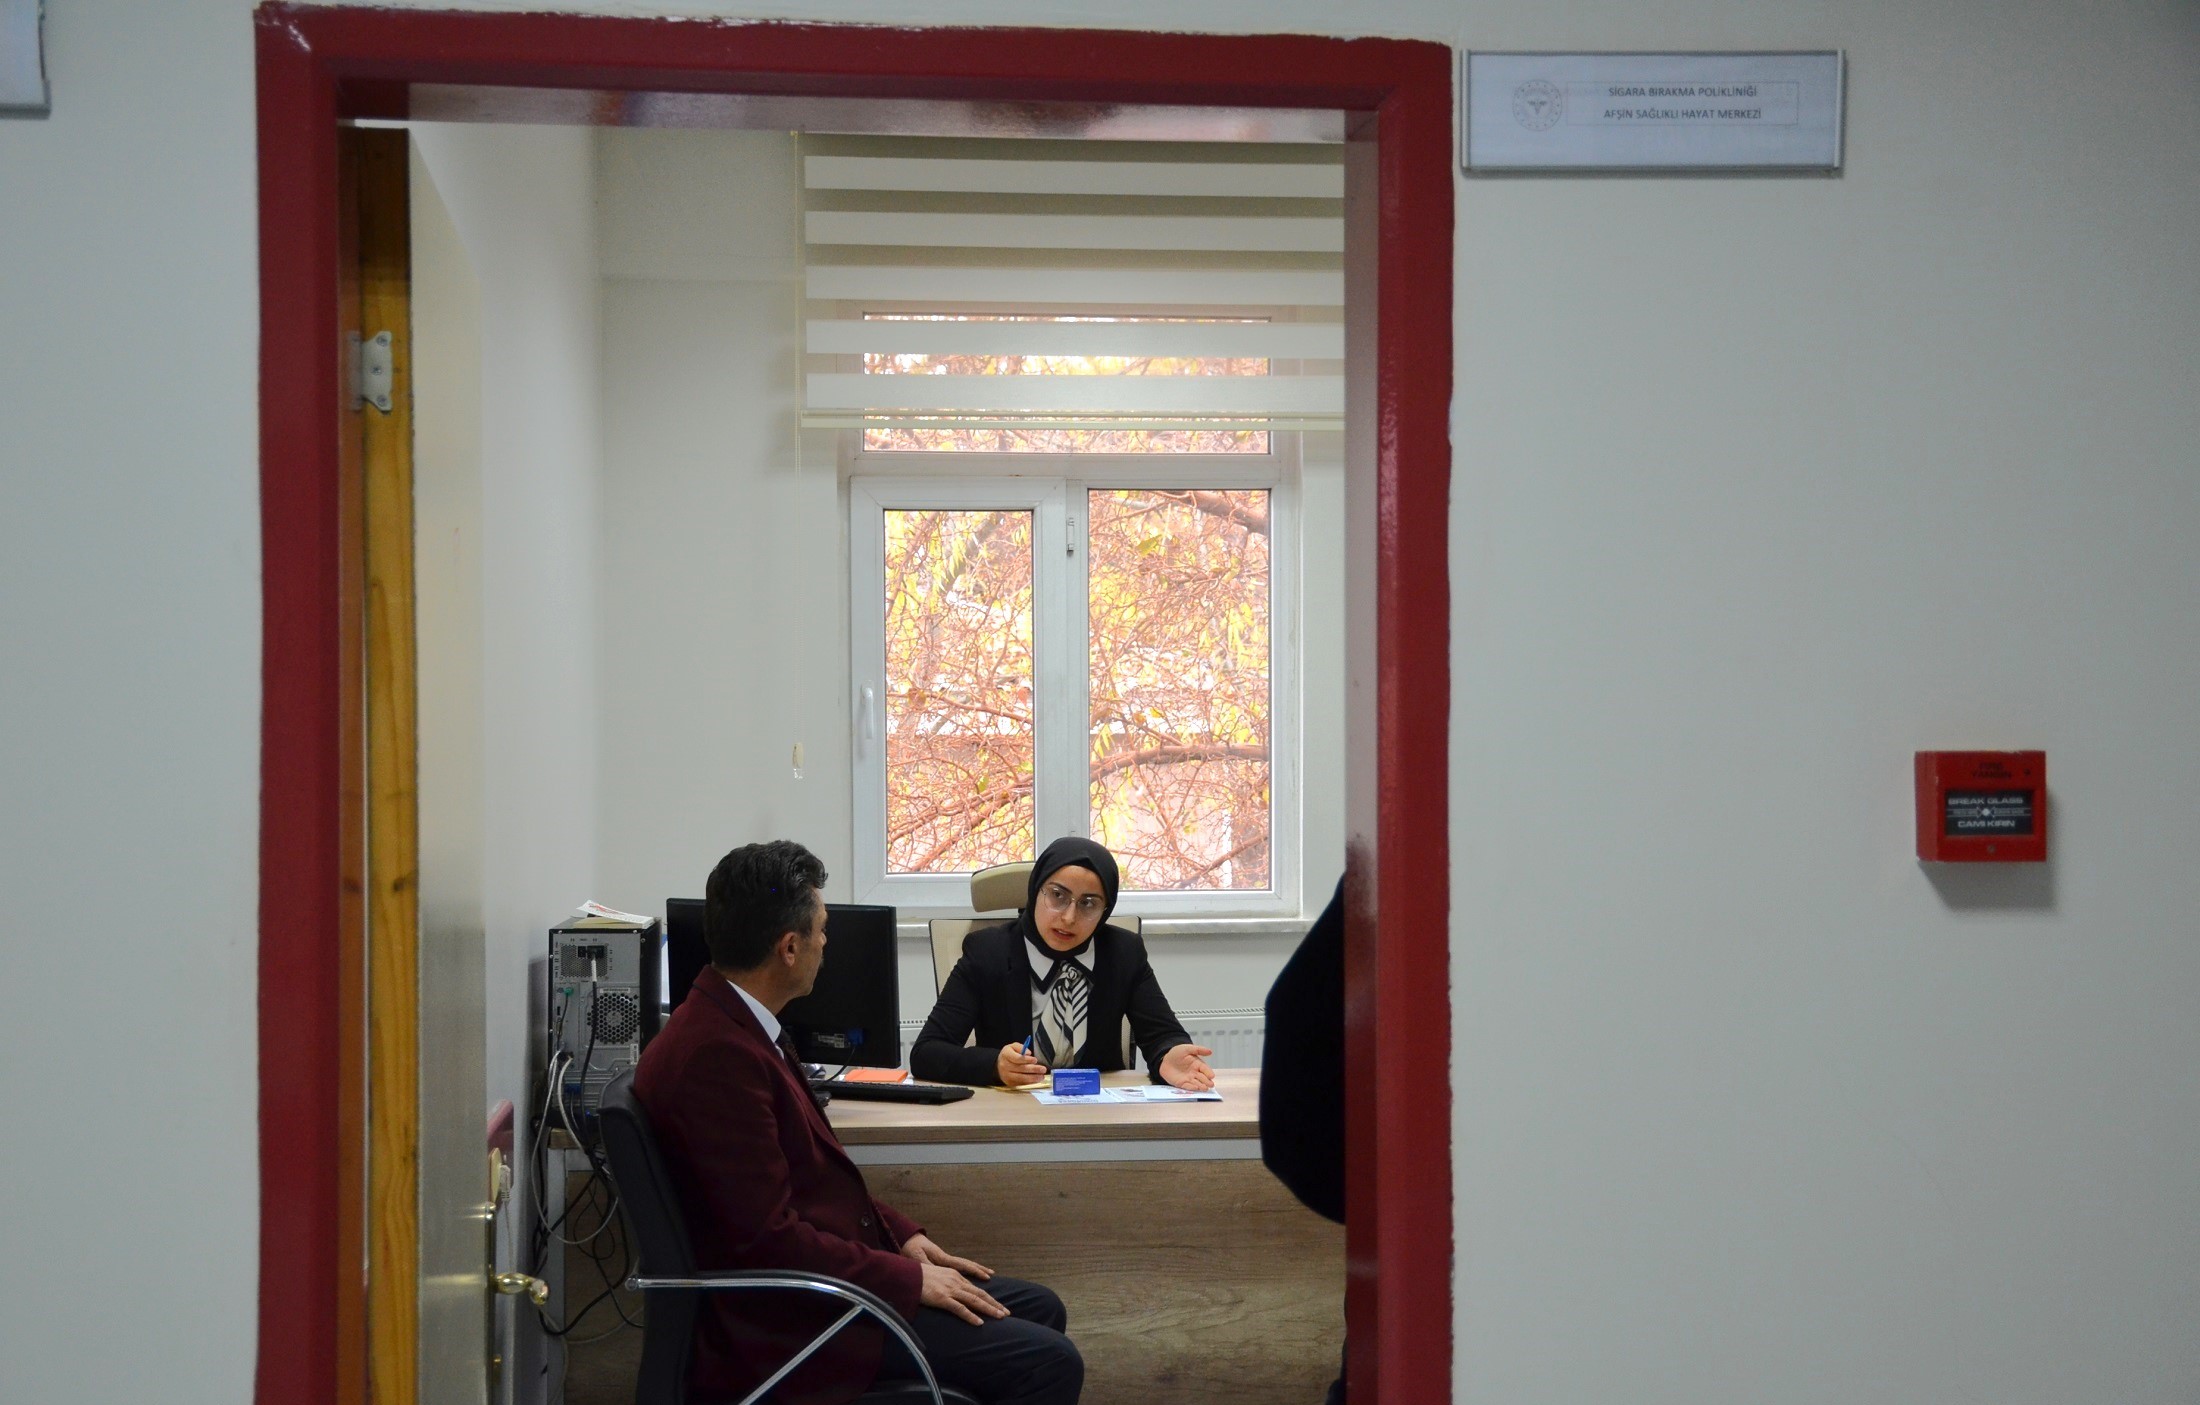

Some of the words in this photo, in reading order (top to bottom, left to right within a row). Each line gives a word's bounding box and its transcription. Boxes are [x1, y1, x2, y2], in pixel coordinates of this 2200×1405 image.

[1608, 85, 1646, 97] SİGARA
[1648, 87, 1695, 97] BIRAKMA
[1698, 85, 1757, 97] POLİKLİNİĞİ
[1603, 108, 1633, 120] AFŞİN
[1635, 107, 1679, 119] SAĞLIKLI
[1681, 109, 1714, 119] HAYAT
[1717, 108, 1761, 119] MERKEZİ
[1948, 797, 1985, 805] BREAK
[1957, 820, 1986, 828] CAMI
